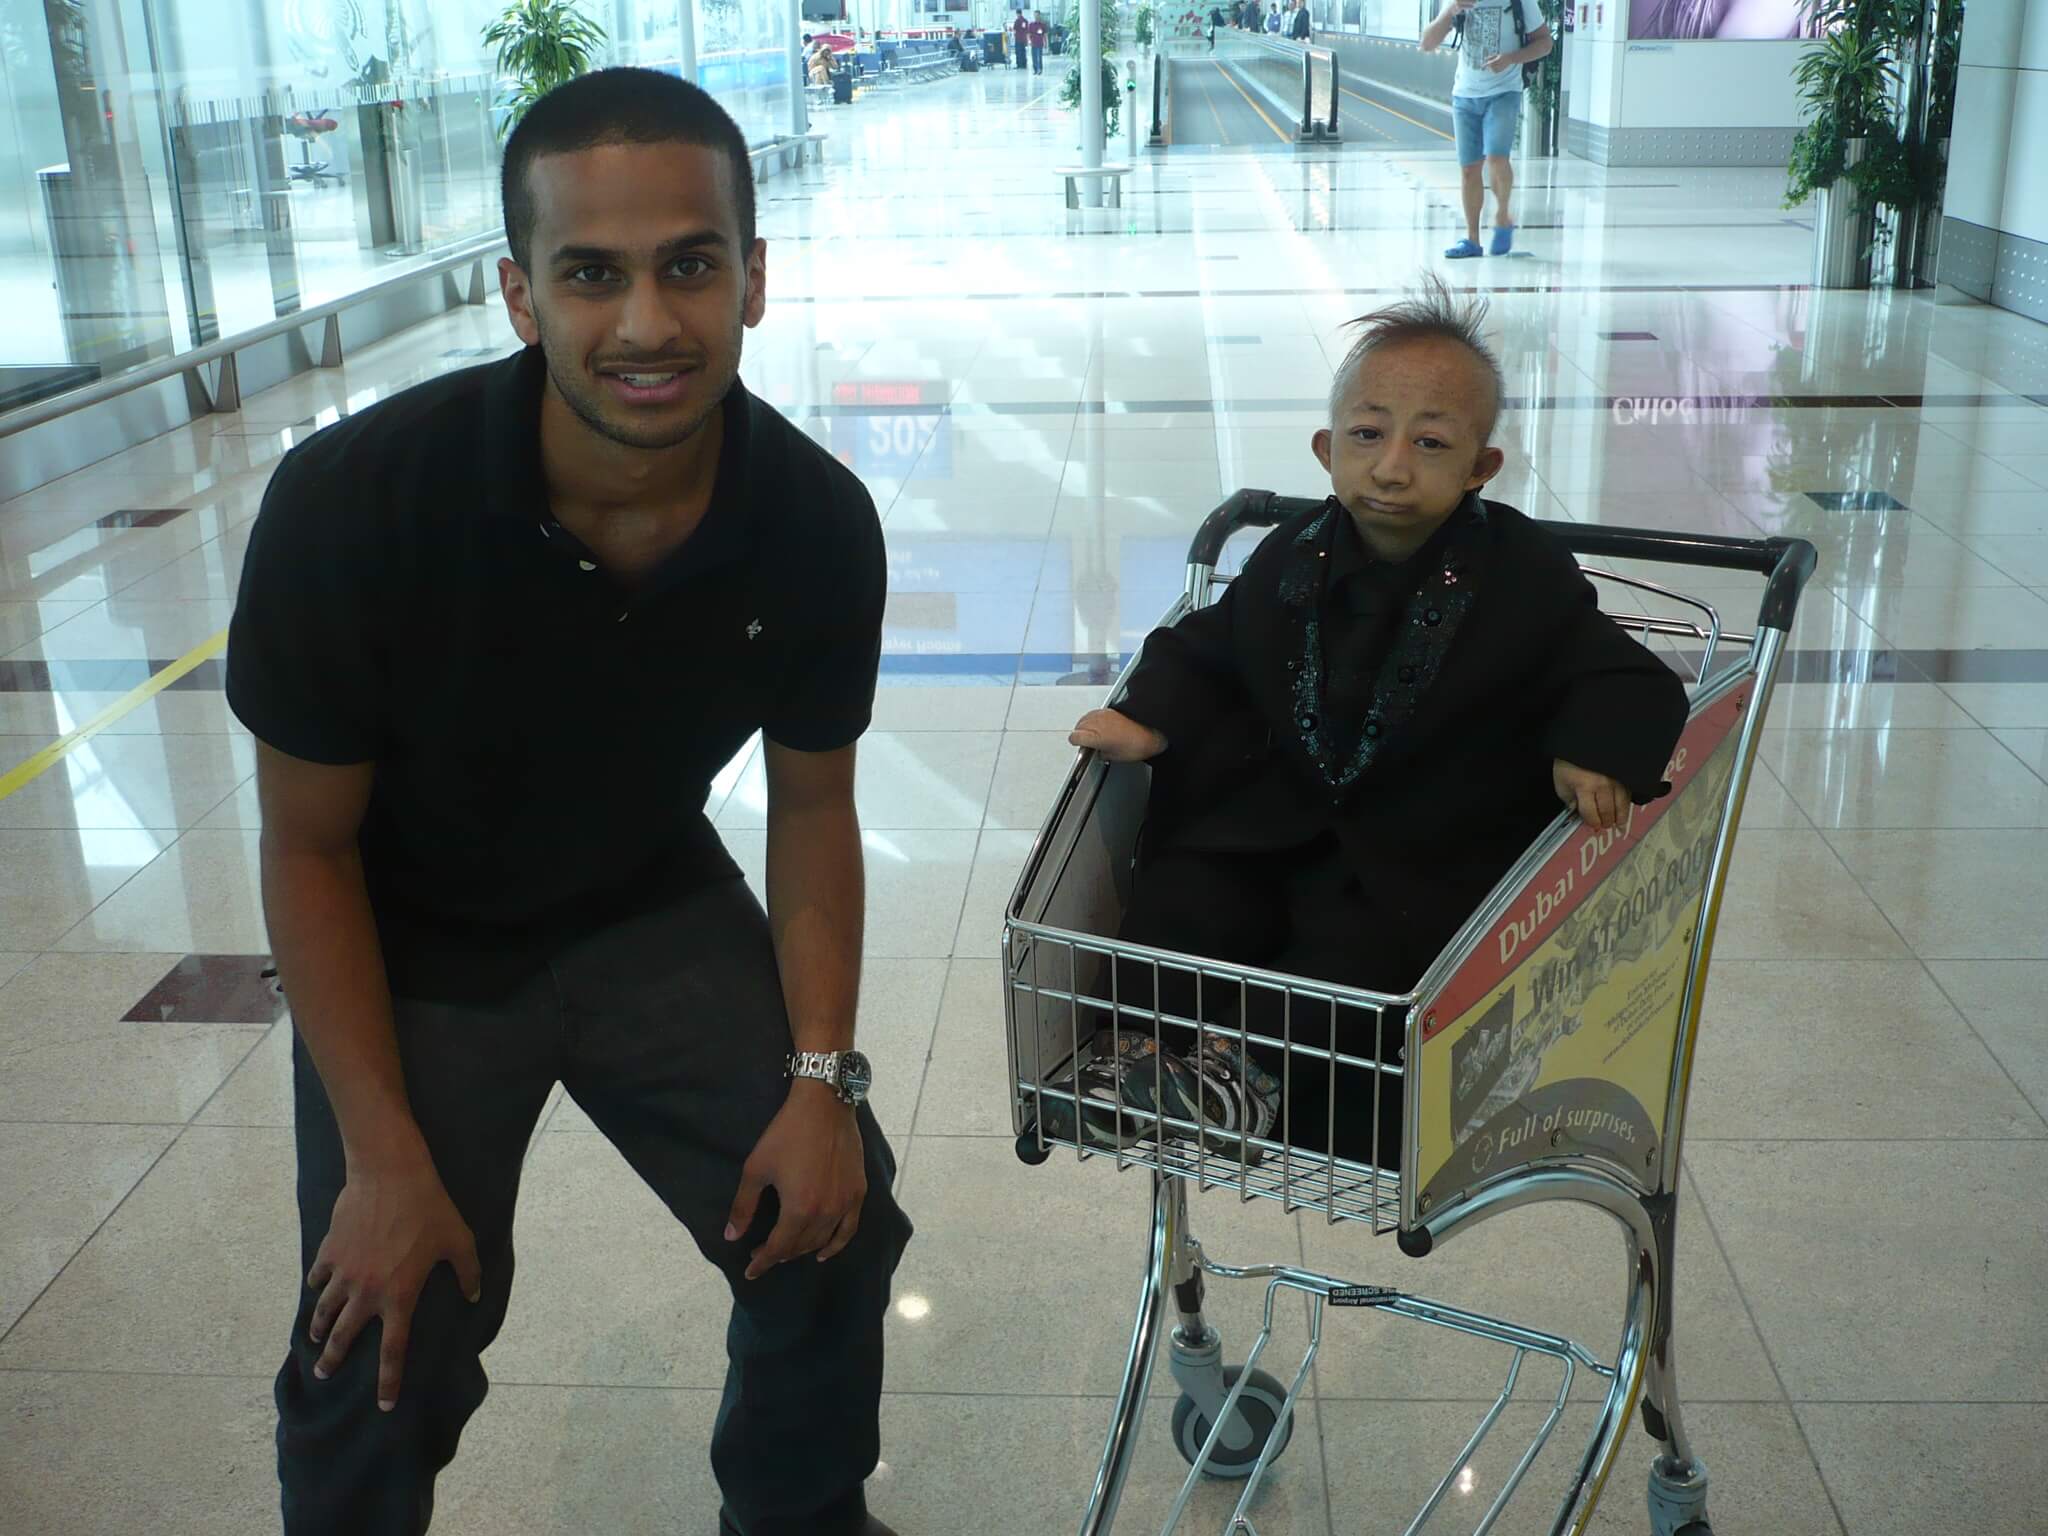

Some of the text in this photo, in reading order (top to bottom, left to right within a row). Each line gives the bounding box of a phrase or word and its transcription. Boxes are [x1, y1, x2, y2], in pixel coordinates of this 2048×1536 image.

[1498, 868, 1574, 964] Dubai
[1498, 1105, 1636, 1155] Full of surprises.
